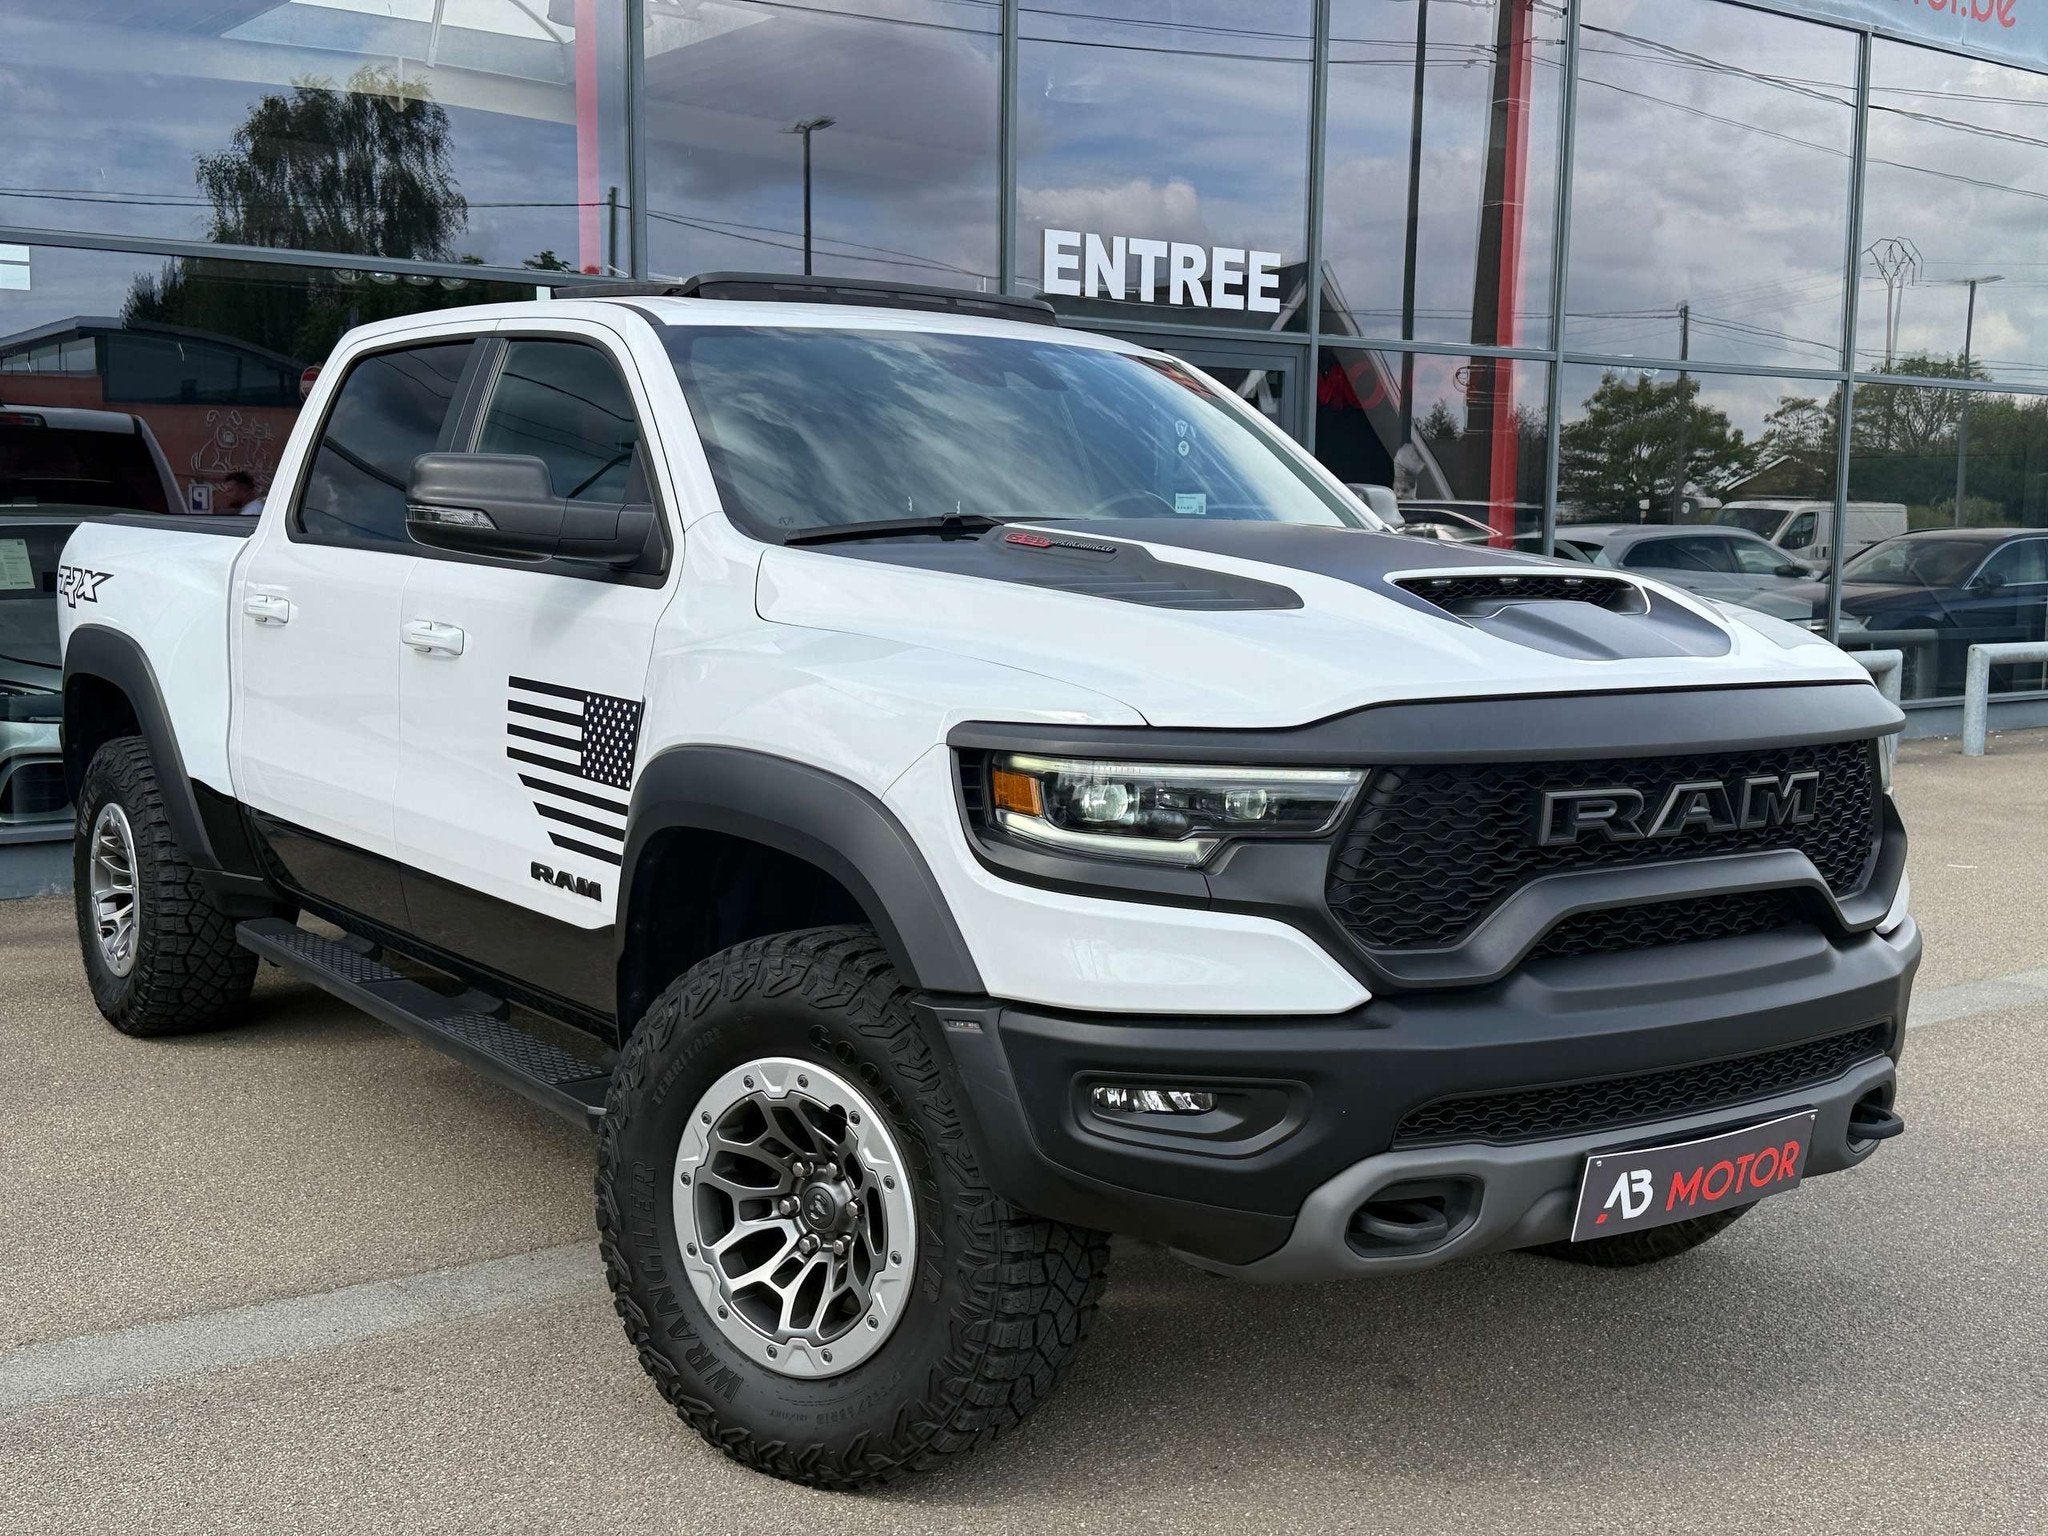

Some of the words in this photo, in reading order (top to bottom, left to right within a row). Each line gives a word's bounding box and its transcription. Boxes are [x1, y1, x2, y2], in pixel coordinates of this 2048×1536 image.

[1043, 228, 1282, 314] ENTREE
[58, 565, 115, 609] TRX
[1538, 770, 1821, 847] RAM
[530, 861, 603, 903] RAM
[1665, 1140, 1800, 1212] MOTOR
[631, 1161, 744, 1403] WRANGLER
